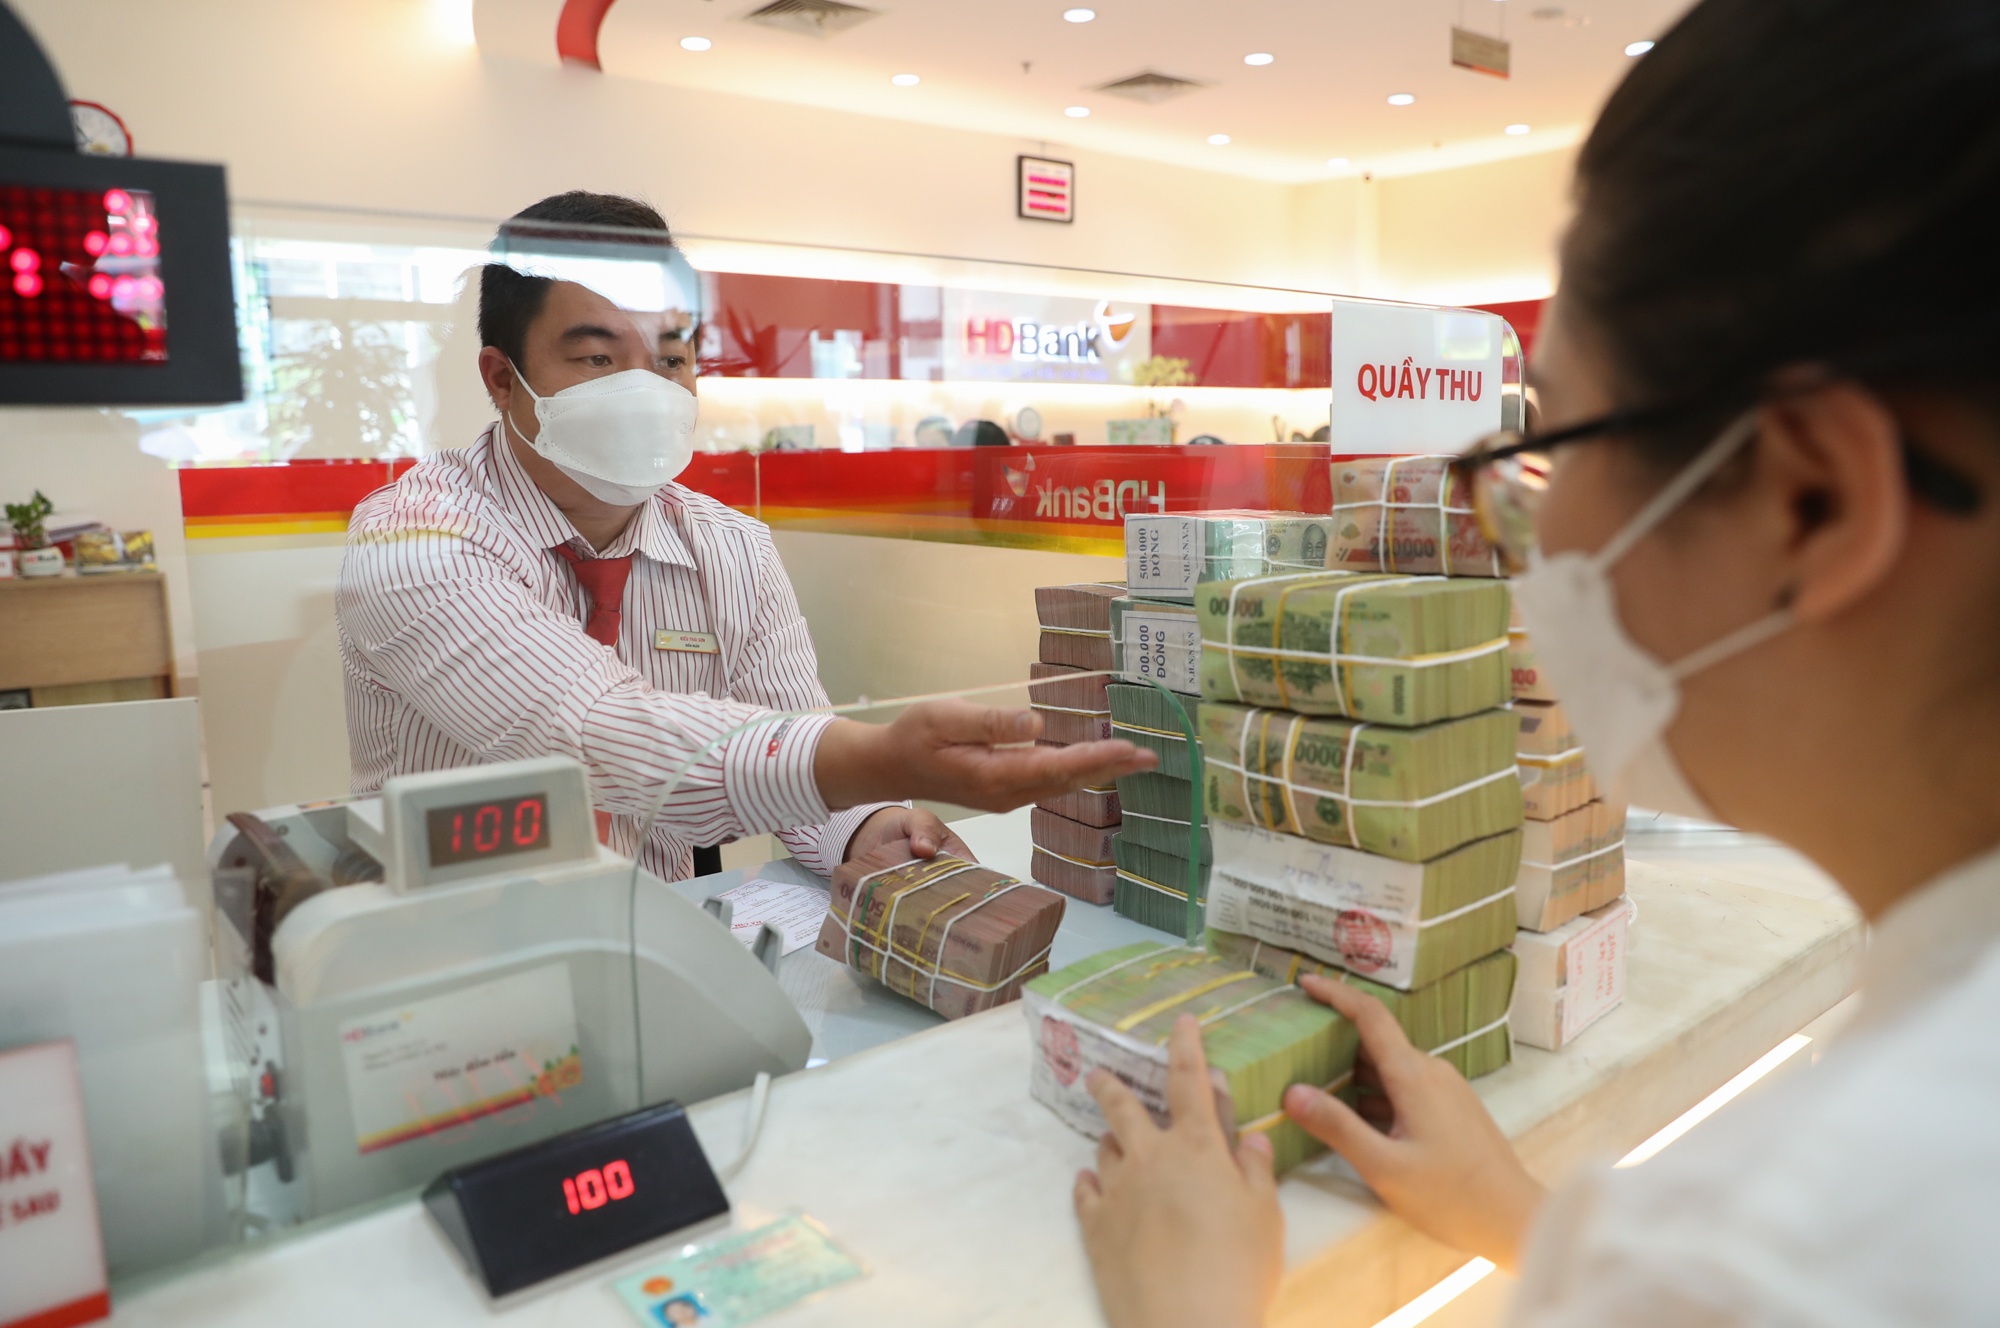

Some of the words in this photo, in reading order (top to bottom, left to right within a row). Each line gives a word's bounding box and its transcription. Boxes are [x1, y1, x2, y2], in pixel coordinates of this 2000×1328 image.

[967, 318, 1101, 358] HDBank
[1357, 357, 1431, 402] QUẦY
[1436, 368, 1482, 401] THU
[1138, 528, 1148, 580] 500.000
[1182, 522, 1190, 583] N.H.N.N.V.N
[1209, 597, 1264, 618] 10000
[1152, 630, 1166, 679] ĐỒNG
[451, 799, 542, 854] 100
[562, 1159, 635, 1216] 100
